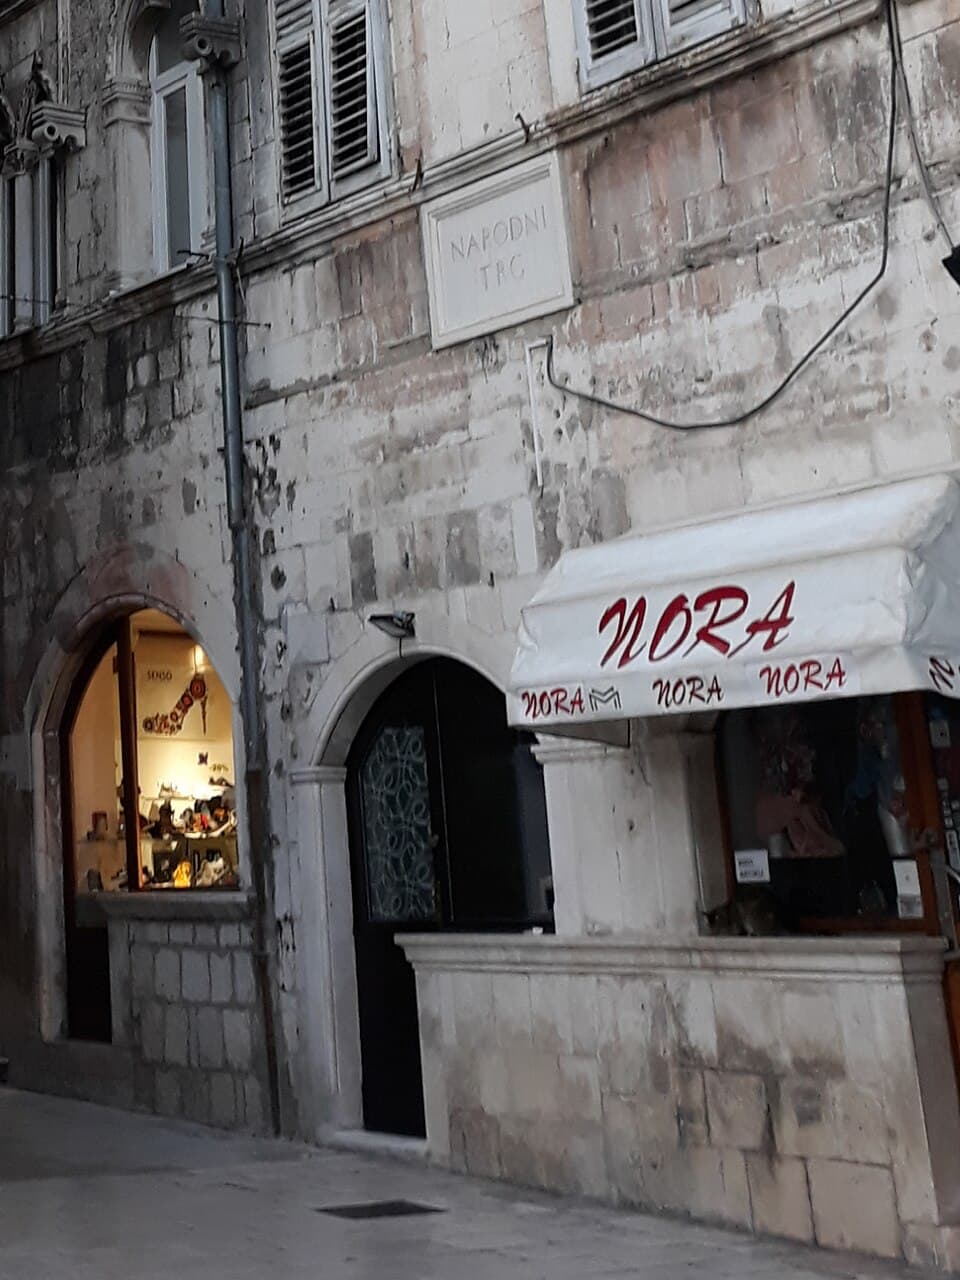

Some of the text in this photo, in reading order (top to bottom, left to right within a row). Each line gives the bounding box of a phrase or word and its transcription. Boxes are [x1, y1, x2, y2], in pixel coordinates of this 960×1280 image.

[598, 580, 796, 670] NORA
[521, 687, 586, 719] NORA
[652, 674, 725, 708] NORA
[759, 656, 848, 698] NORA
